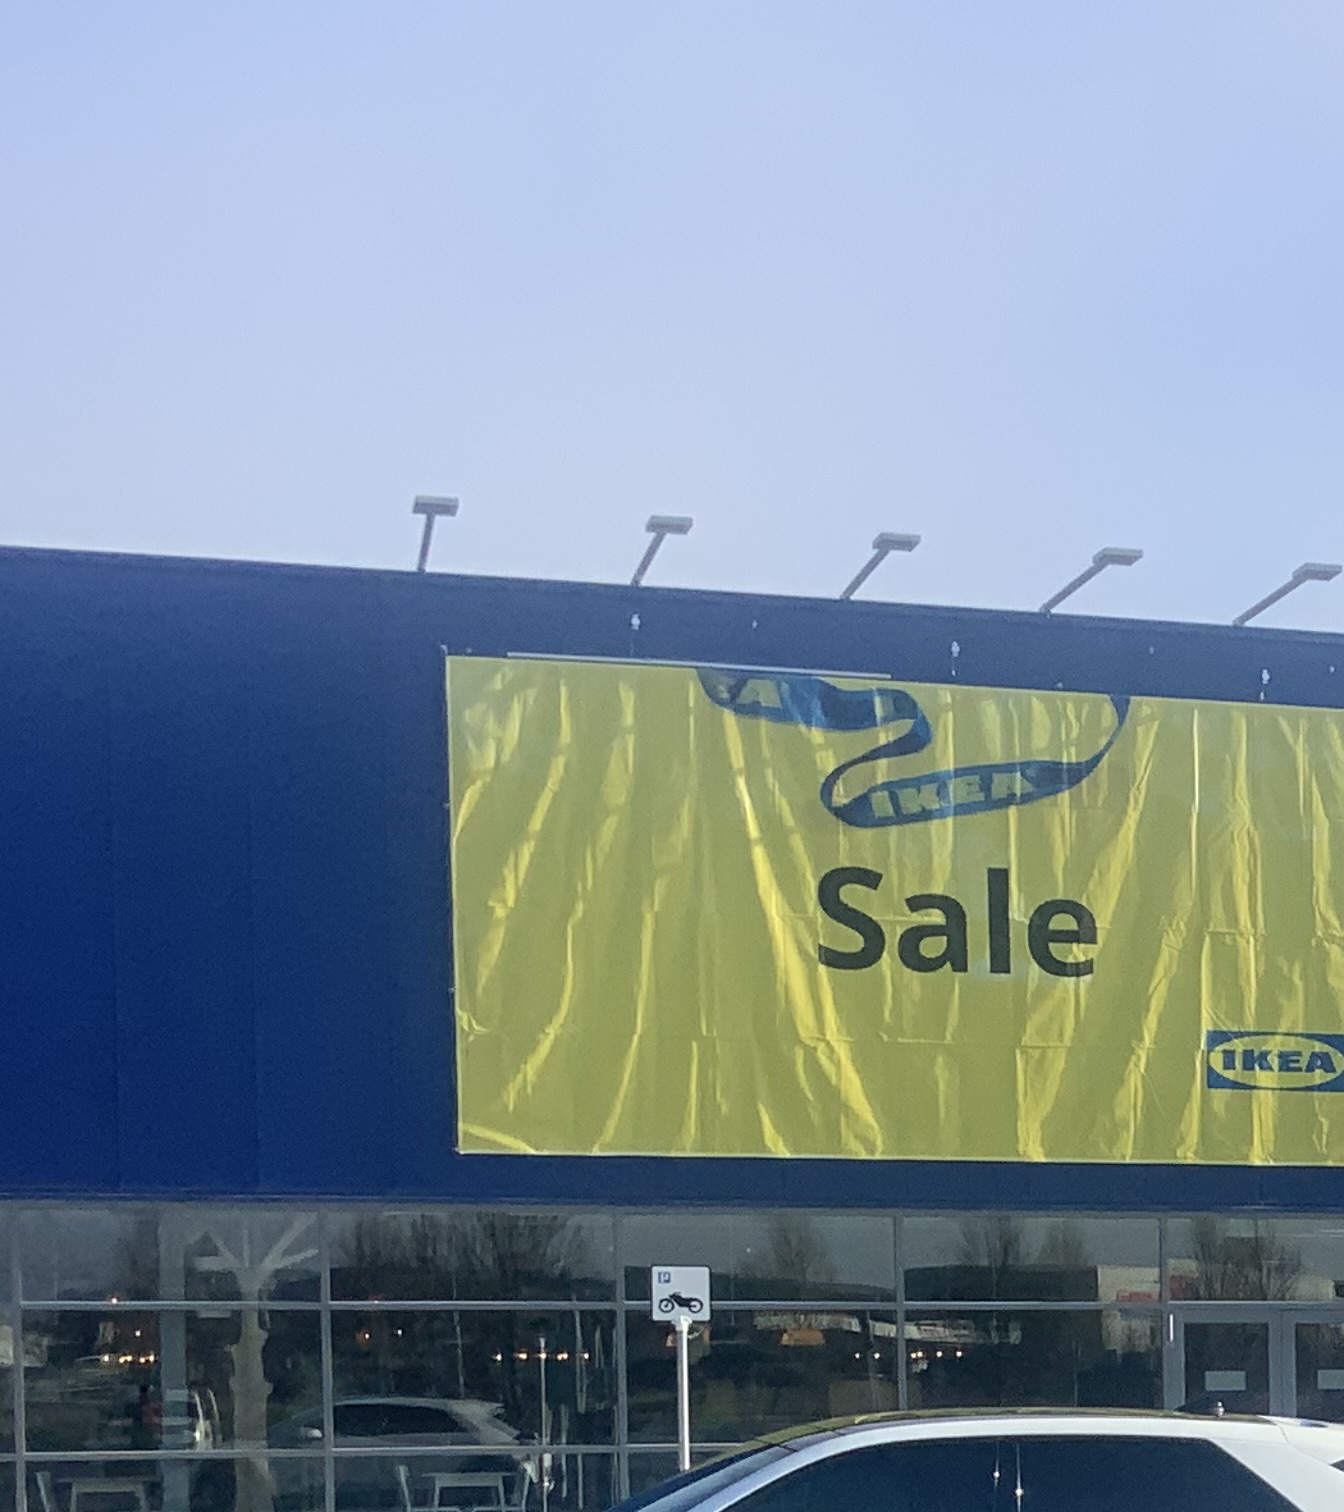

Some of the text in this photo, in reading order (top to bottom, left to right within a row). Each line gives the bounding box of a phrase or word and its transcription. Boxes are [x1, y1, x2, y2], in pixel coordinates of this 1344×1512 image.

[817, 865, 1098, 978] Sale
[1221, 1048, 1338, 1074] IKEA
[659, 1272, 671, 1284] P
